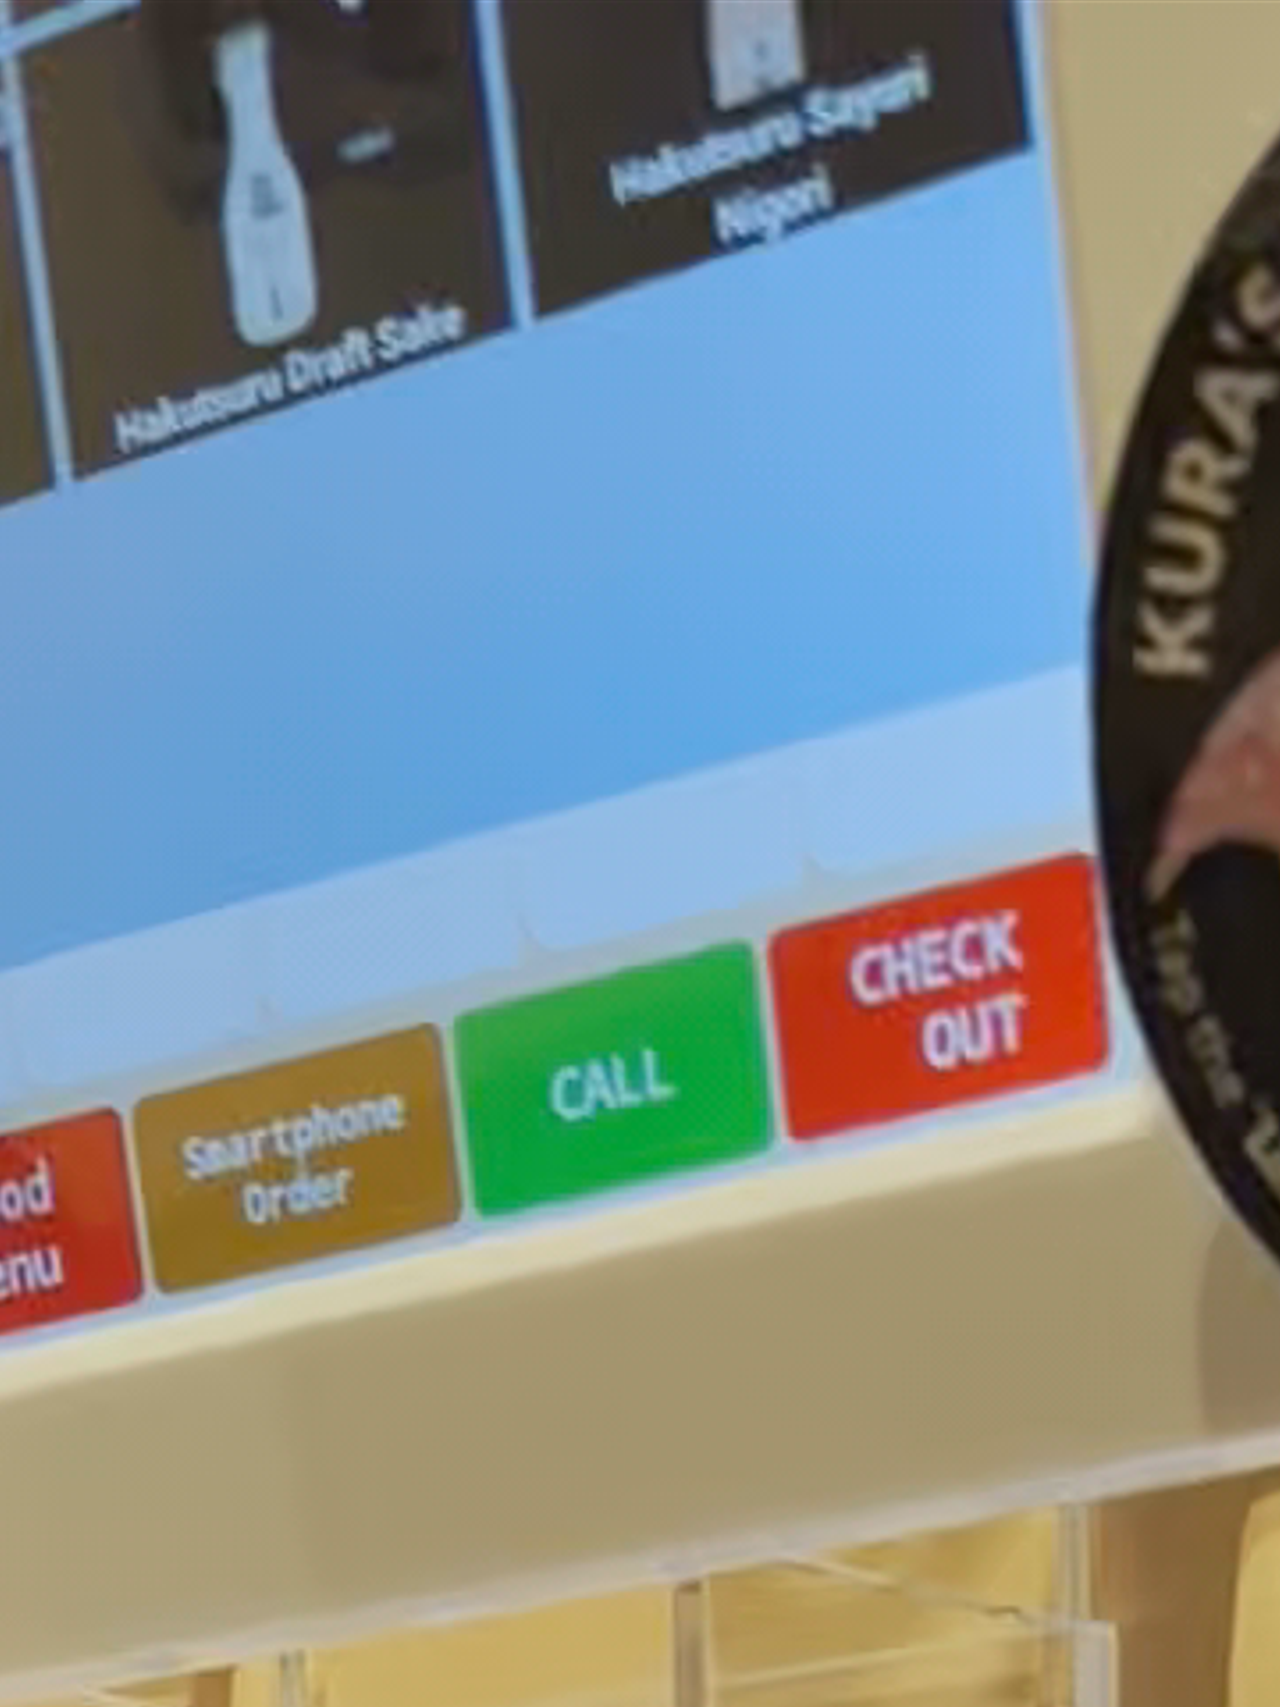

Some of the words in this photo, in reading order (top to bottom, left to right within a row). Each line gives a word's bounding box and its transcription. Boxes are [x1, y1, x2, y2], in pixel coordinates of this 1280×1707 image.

[375, 303, 466, 361] Sake
[851, 909, 1023, 1007] CHECK
[923, 994, 1026, 1070] OUT
[550, 1047, 678, 1121] CALL
[182, 1094, 406, 1181] Smartphone
[243, 1168, 354, 1225] Order
